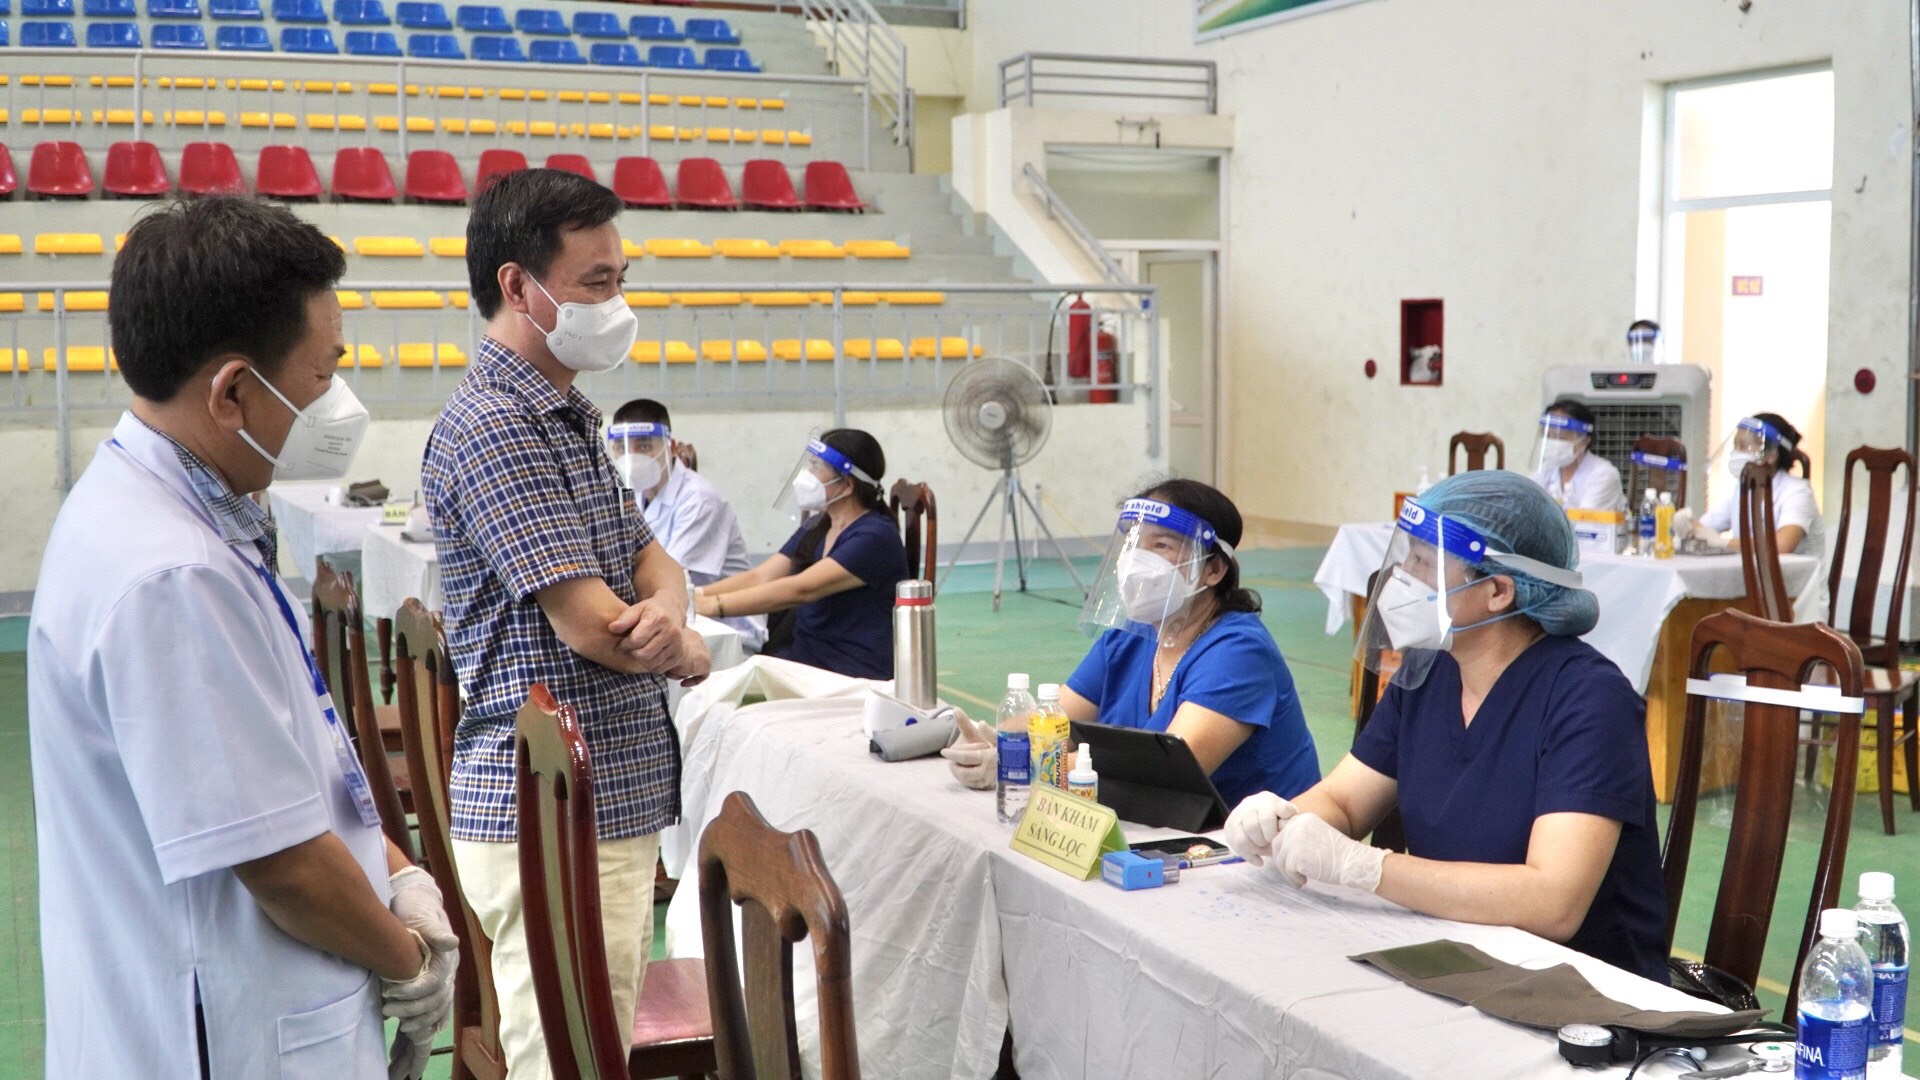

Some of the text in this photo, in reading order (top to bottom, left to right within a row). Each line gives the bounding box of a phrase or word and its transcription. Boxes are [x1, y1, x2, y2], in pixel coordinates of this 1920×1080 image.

[1130, 502, 1163, 514] shield
[1037, 796, 1099, 832] BÀN KHÁM
[1058, 835, 1087, 858] LỌC
